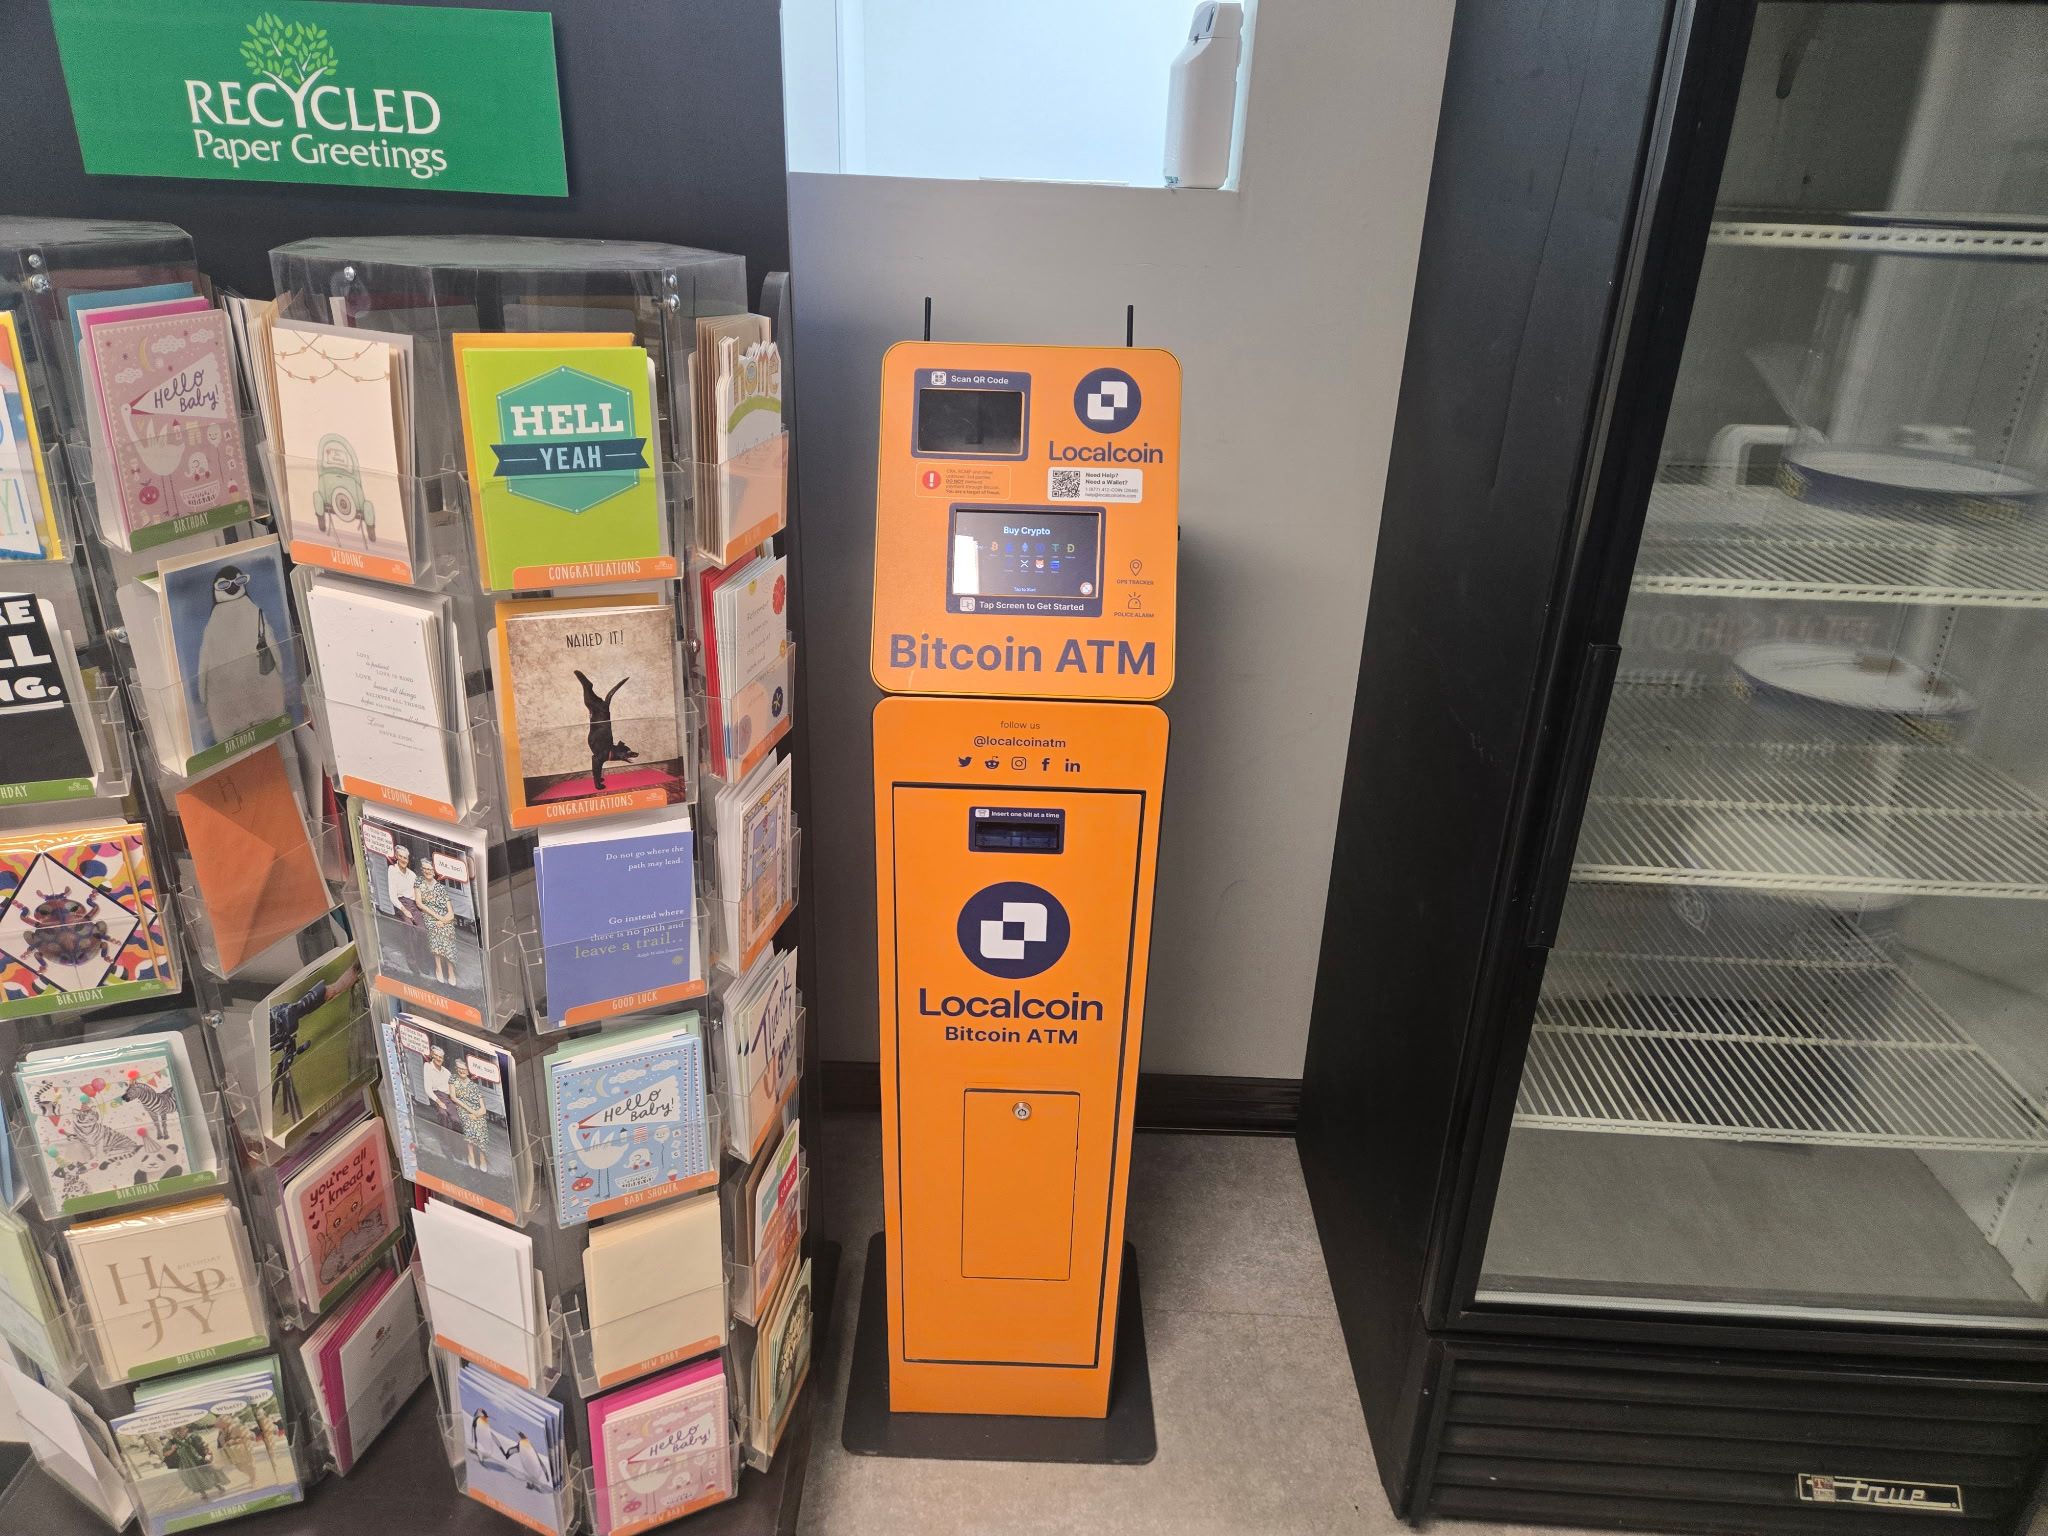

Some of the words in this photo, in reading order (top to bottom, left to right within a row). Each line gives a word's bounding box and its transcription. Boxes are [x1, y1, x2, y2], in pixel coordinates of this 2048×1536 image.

[184, 72, 441, 134] RECYCLED
[193, 129, 281, 168] Paper
[291, 133, 447, 179] Greetings
[154, 369, 204, 409] Hello
[951, 375, 971, 384] Scan
[973, 376, 985, 385] QR
[987, 376, 1009, 385] Code
[179, 384, 219, 412] Baby!
[510, 403, 624, 436] HELL
[539, 445, 602, 471] YEAH
[1048, 441, 1163, 464] Localcoin
[173, 511, 210, 533] BIRTHDAY
[1003, 526, 1020, 536] Buy
[1021, 527, 1051, 537] Crypto
[330, 549, 364, 569] WEDDING
[548, 560, 641, 581] CONGRATULATIONS
[979, 601, 995, 610] Tap
[996, 602, 1025, 610] Screen
[1053, 603, 1085, 611] Started
[566, 632, 603, 649] NAILED
[609, 630, 625, 646] IT!
[889, 633, 1042, 673] Bitcoin
[1055, 639, 1156, 676] ATM
[1000, 720, 1028, 729] follow
[1030, 722, 1041, 730] us
[225, 731, 256, 753] BIRTHDAY
[973, 735, 1066, 748] @localcoinatm
[381, 787, 413, 806] WEDDING
[546, 795, 633, 818] CONGRATULATIONS
[605, 853, 618, 861] Do
[635, 851, 645, 859] go
[647, 847, 669, 855] where
[628, 860, 646, 871] path
[648, 860, 662, 868] may
[665, 858, 684, 866] lead.
[608, 916, 623, 925] Go
[625, 911, 656, 922] instead
[658, 908, 684, 917] where
[590, 932, 614, 942] there
[616, 930, 624, 938] is
[626, 928, 640, 936] no
[643, 924, 665, 936] path
[667, 921, 684, 929] and
[574, 944, 617, 960] leave
[622, 942, 630, 951] a
[56, 989, 104, 1006] BIRTHDAY
[403, 985, 449, 1009] ANNIVERSARY
[612, 996, 634, 1010] GOOD
[637, 991, 657, 1004] LUCK
[919, 987, 1103, 1021] Localcoin
[945, 1026, 1020, 1043] Bitcoin
[1026, 1028, 1078, 1045] ATM
[603, 1089, 661, 1122] Hello
[631, 1096, 674, 1122] Baby!
[310, 1165, 349, 1207] you're
[353, 1147, 366, 1166] all
[328, 1163, 363, 1205] knead
[116, 1182, 160, 1200] BIRTHDAY
[624, 1192, 644, 1206] BABY
[647, 1182, 680, 1200] SHOWER
[176, 1349, 217, 1365] BIRTHDAY
[660, 1350, 679, 1365] BABY
[649, 1424, 699, 1457] Hello
[673, 1428, 711, 1453] Baby!
[1850, 1480, 1930, 1503] true
